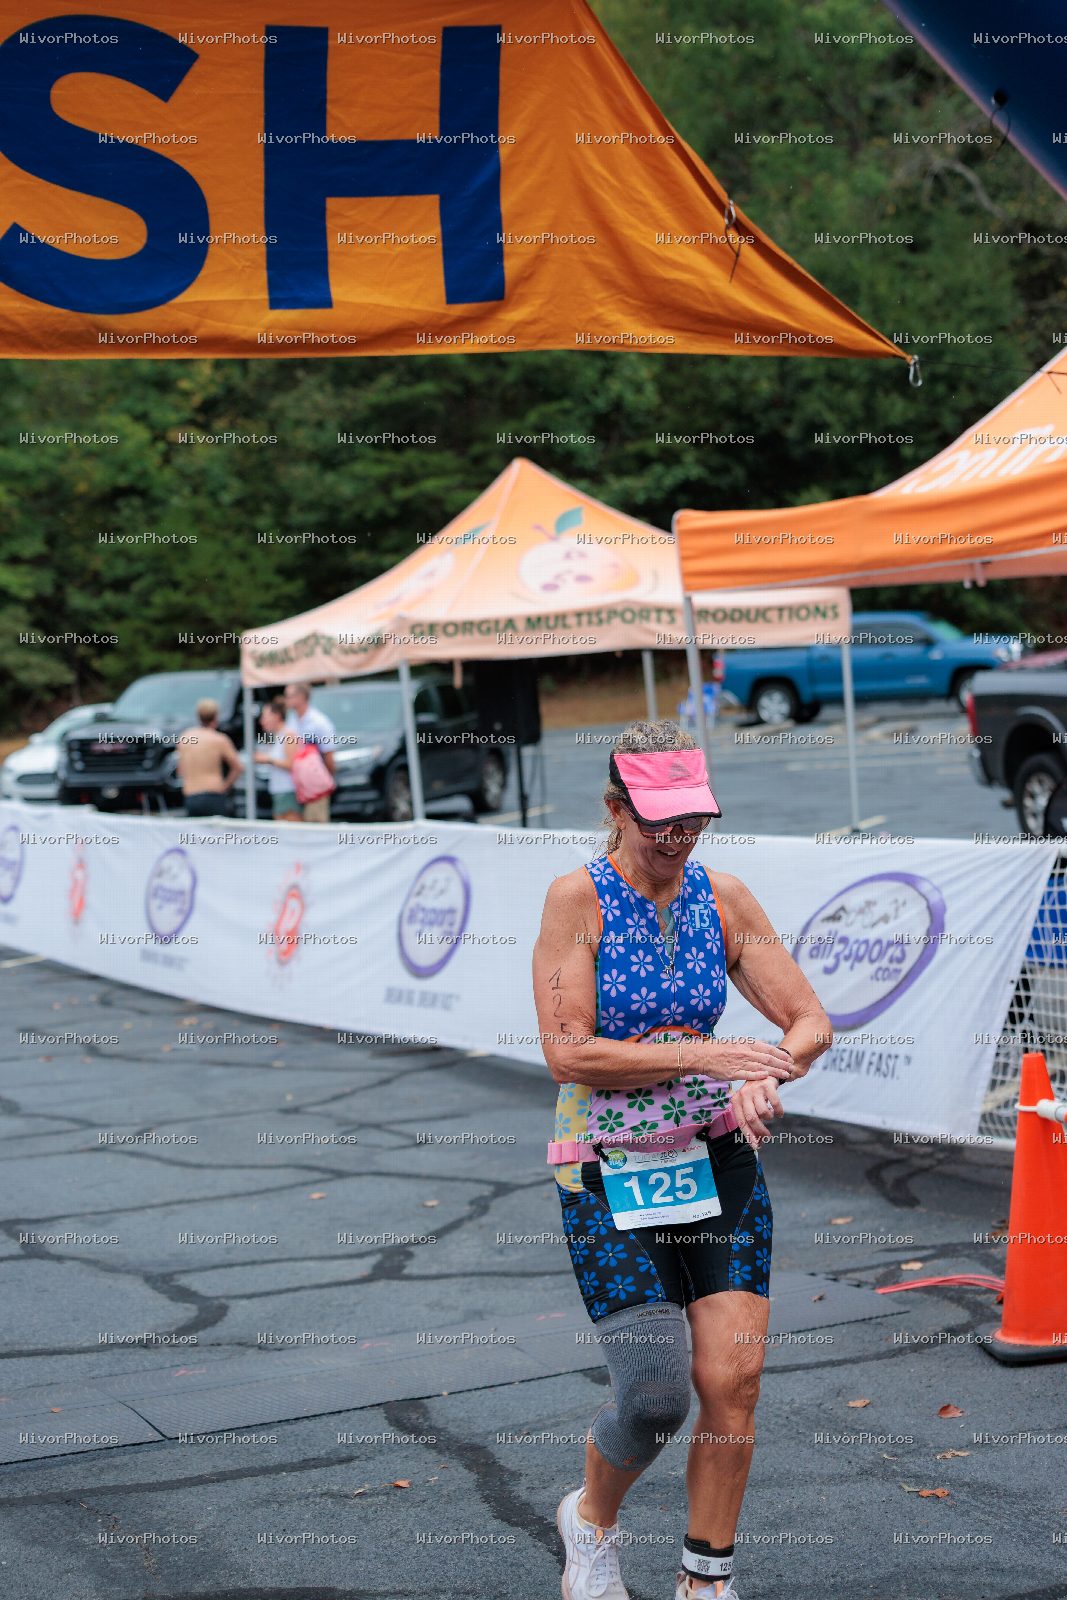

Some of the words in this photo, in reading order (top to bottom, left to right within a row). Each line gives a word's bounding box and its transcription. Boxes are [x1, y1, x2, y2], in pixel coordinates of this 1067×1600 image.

[0, 14, 505, 315] SH
[410, 617, 517, 638] GEORGIA
[524, 607, 677, 630] MULTISPORTS
[695, 602, 840, 624] RODUCTIONS
[690, 904, 710, 929] T3
[808, 929, 907, 975] all3sports
[624, 1167, 698, 1206] 125
